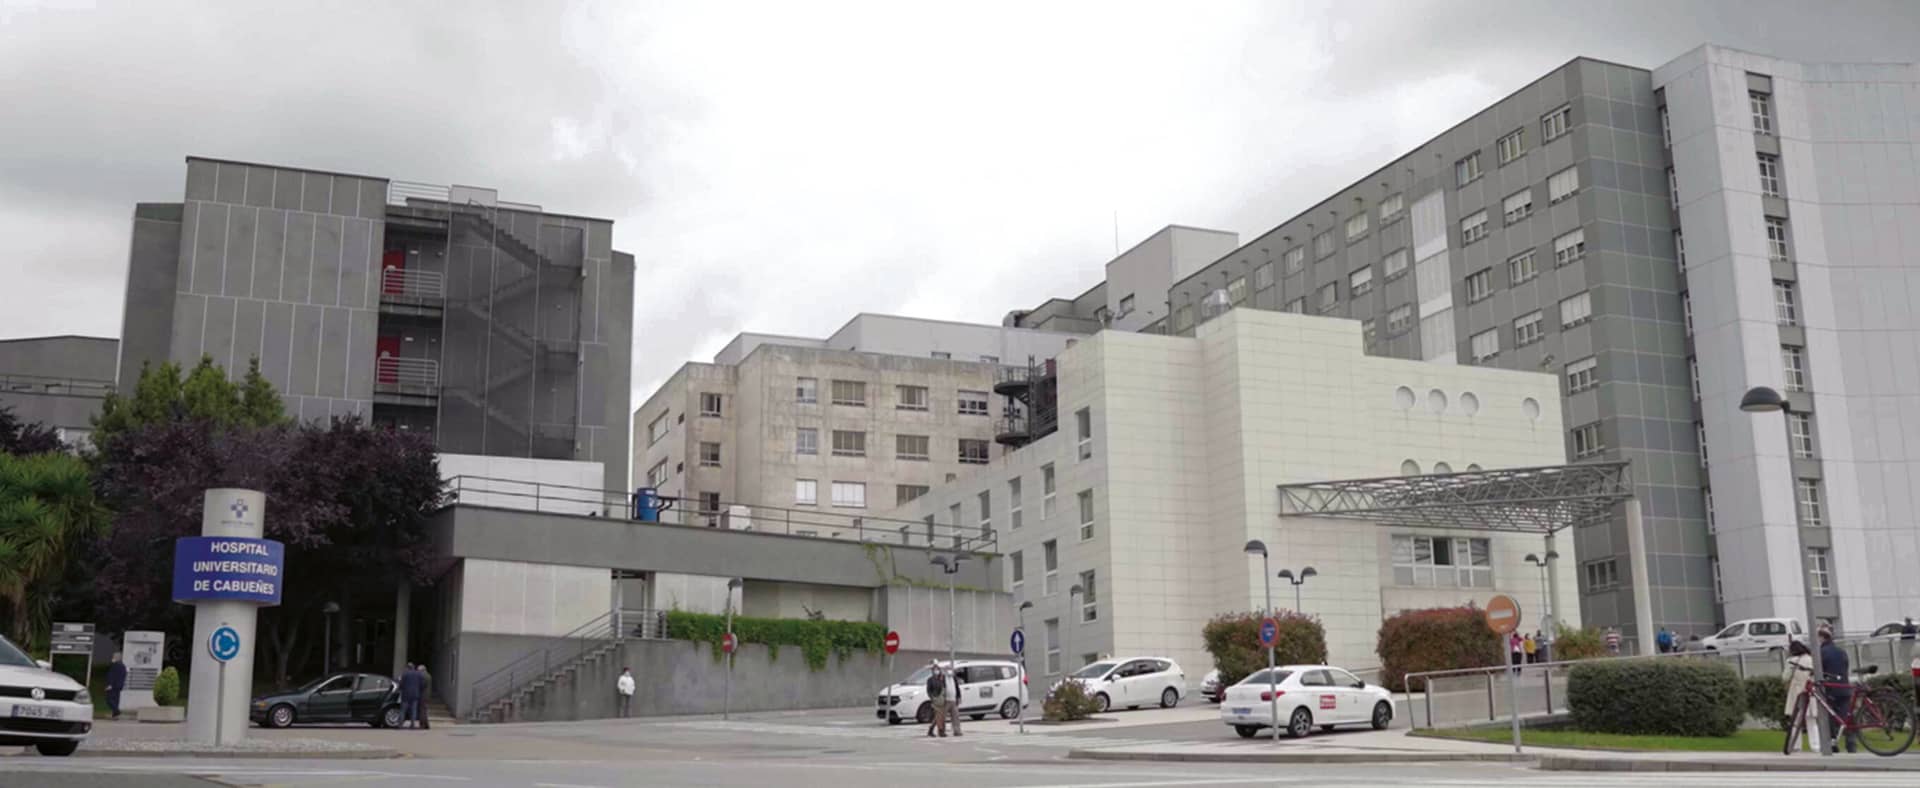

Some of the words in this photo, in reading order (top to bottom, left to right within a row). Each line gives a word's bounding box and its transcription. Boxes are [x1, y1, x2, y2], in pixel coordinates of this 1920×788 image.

[210, 541, 269, 556] HOSPITAL
[193, 561, 278, 577] UNIVERSITARIO
[193, 580, 210, 592] DE
[213, 579, 275, 595] CABUEÑES
